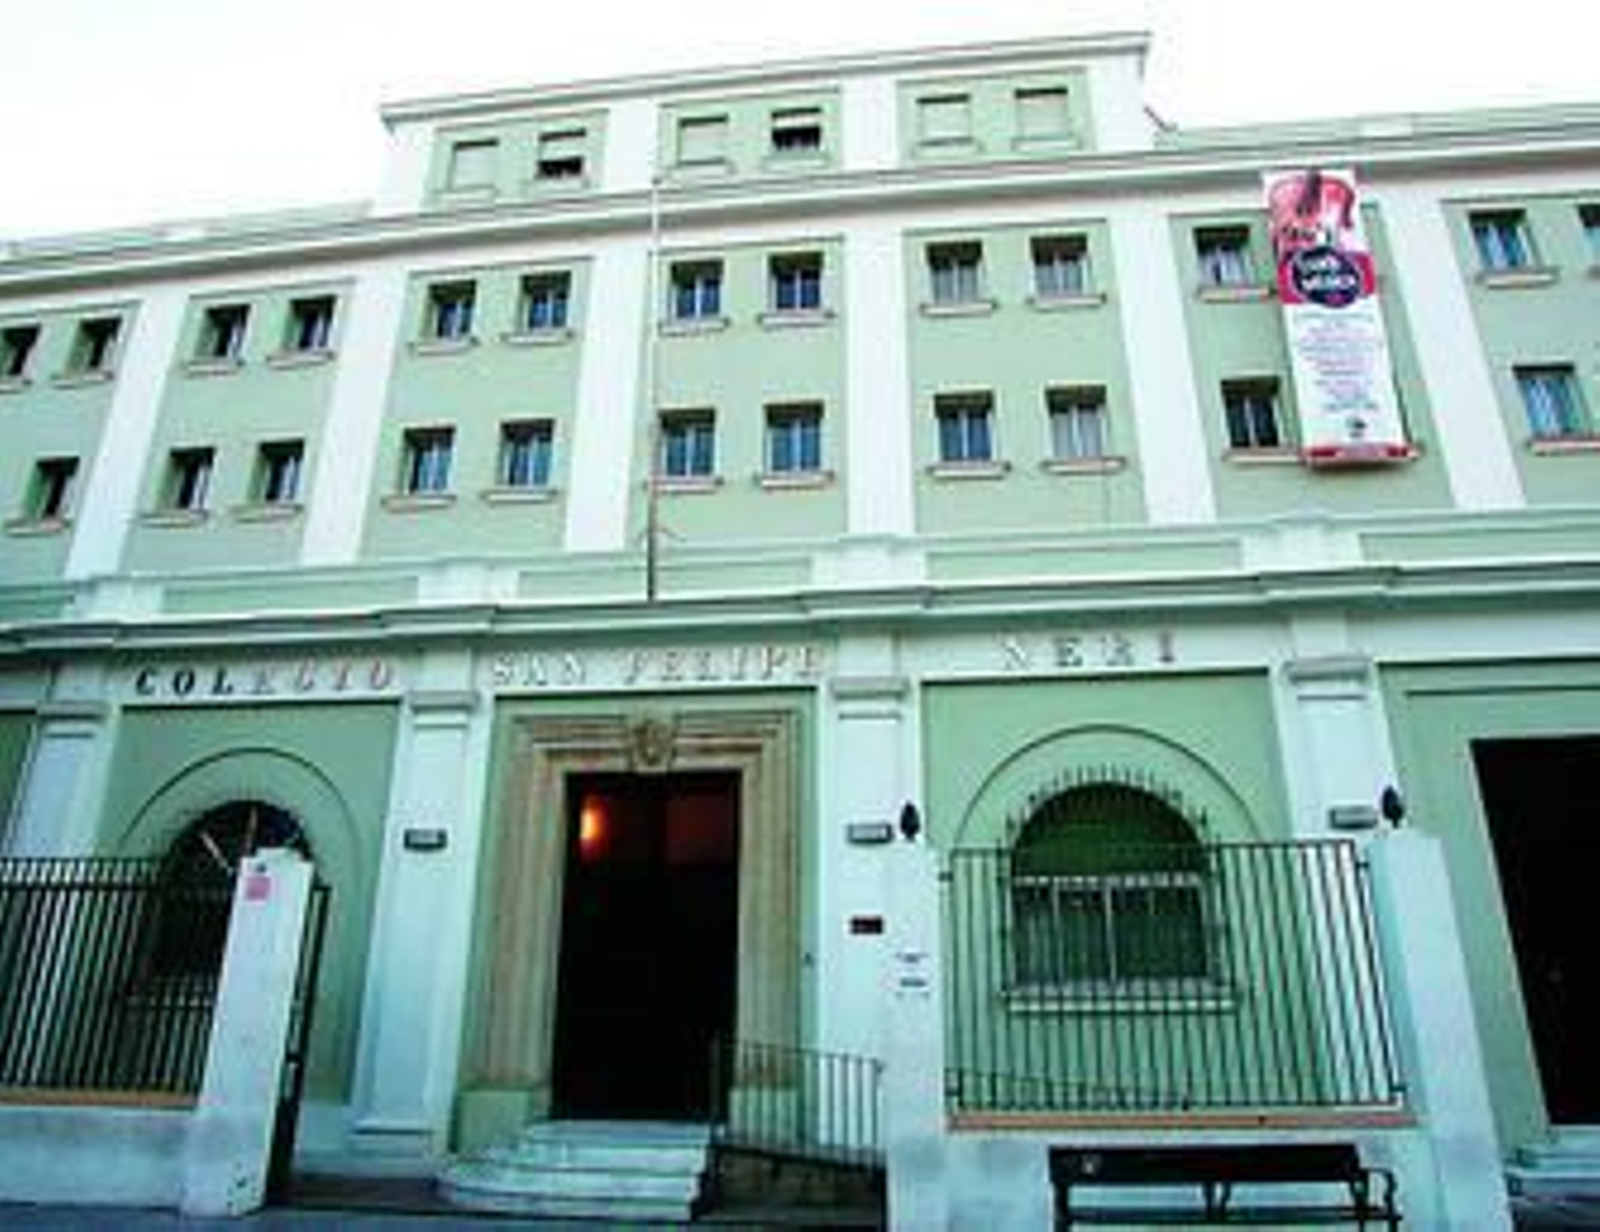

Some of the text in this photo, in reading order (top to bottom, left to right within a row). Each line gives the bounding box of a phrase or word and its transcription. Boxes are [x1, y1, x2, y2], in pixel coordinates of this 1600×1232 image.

[135, 631, 1176, 696] COLEGIO SAN FELIPE NERI
